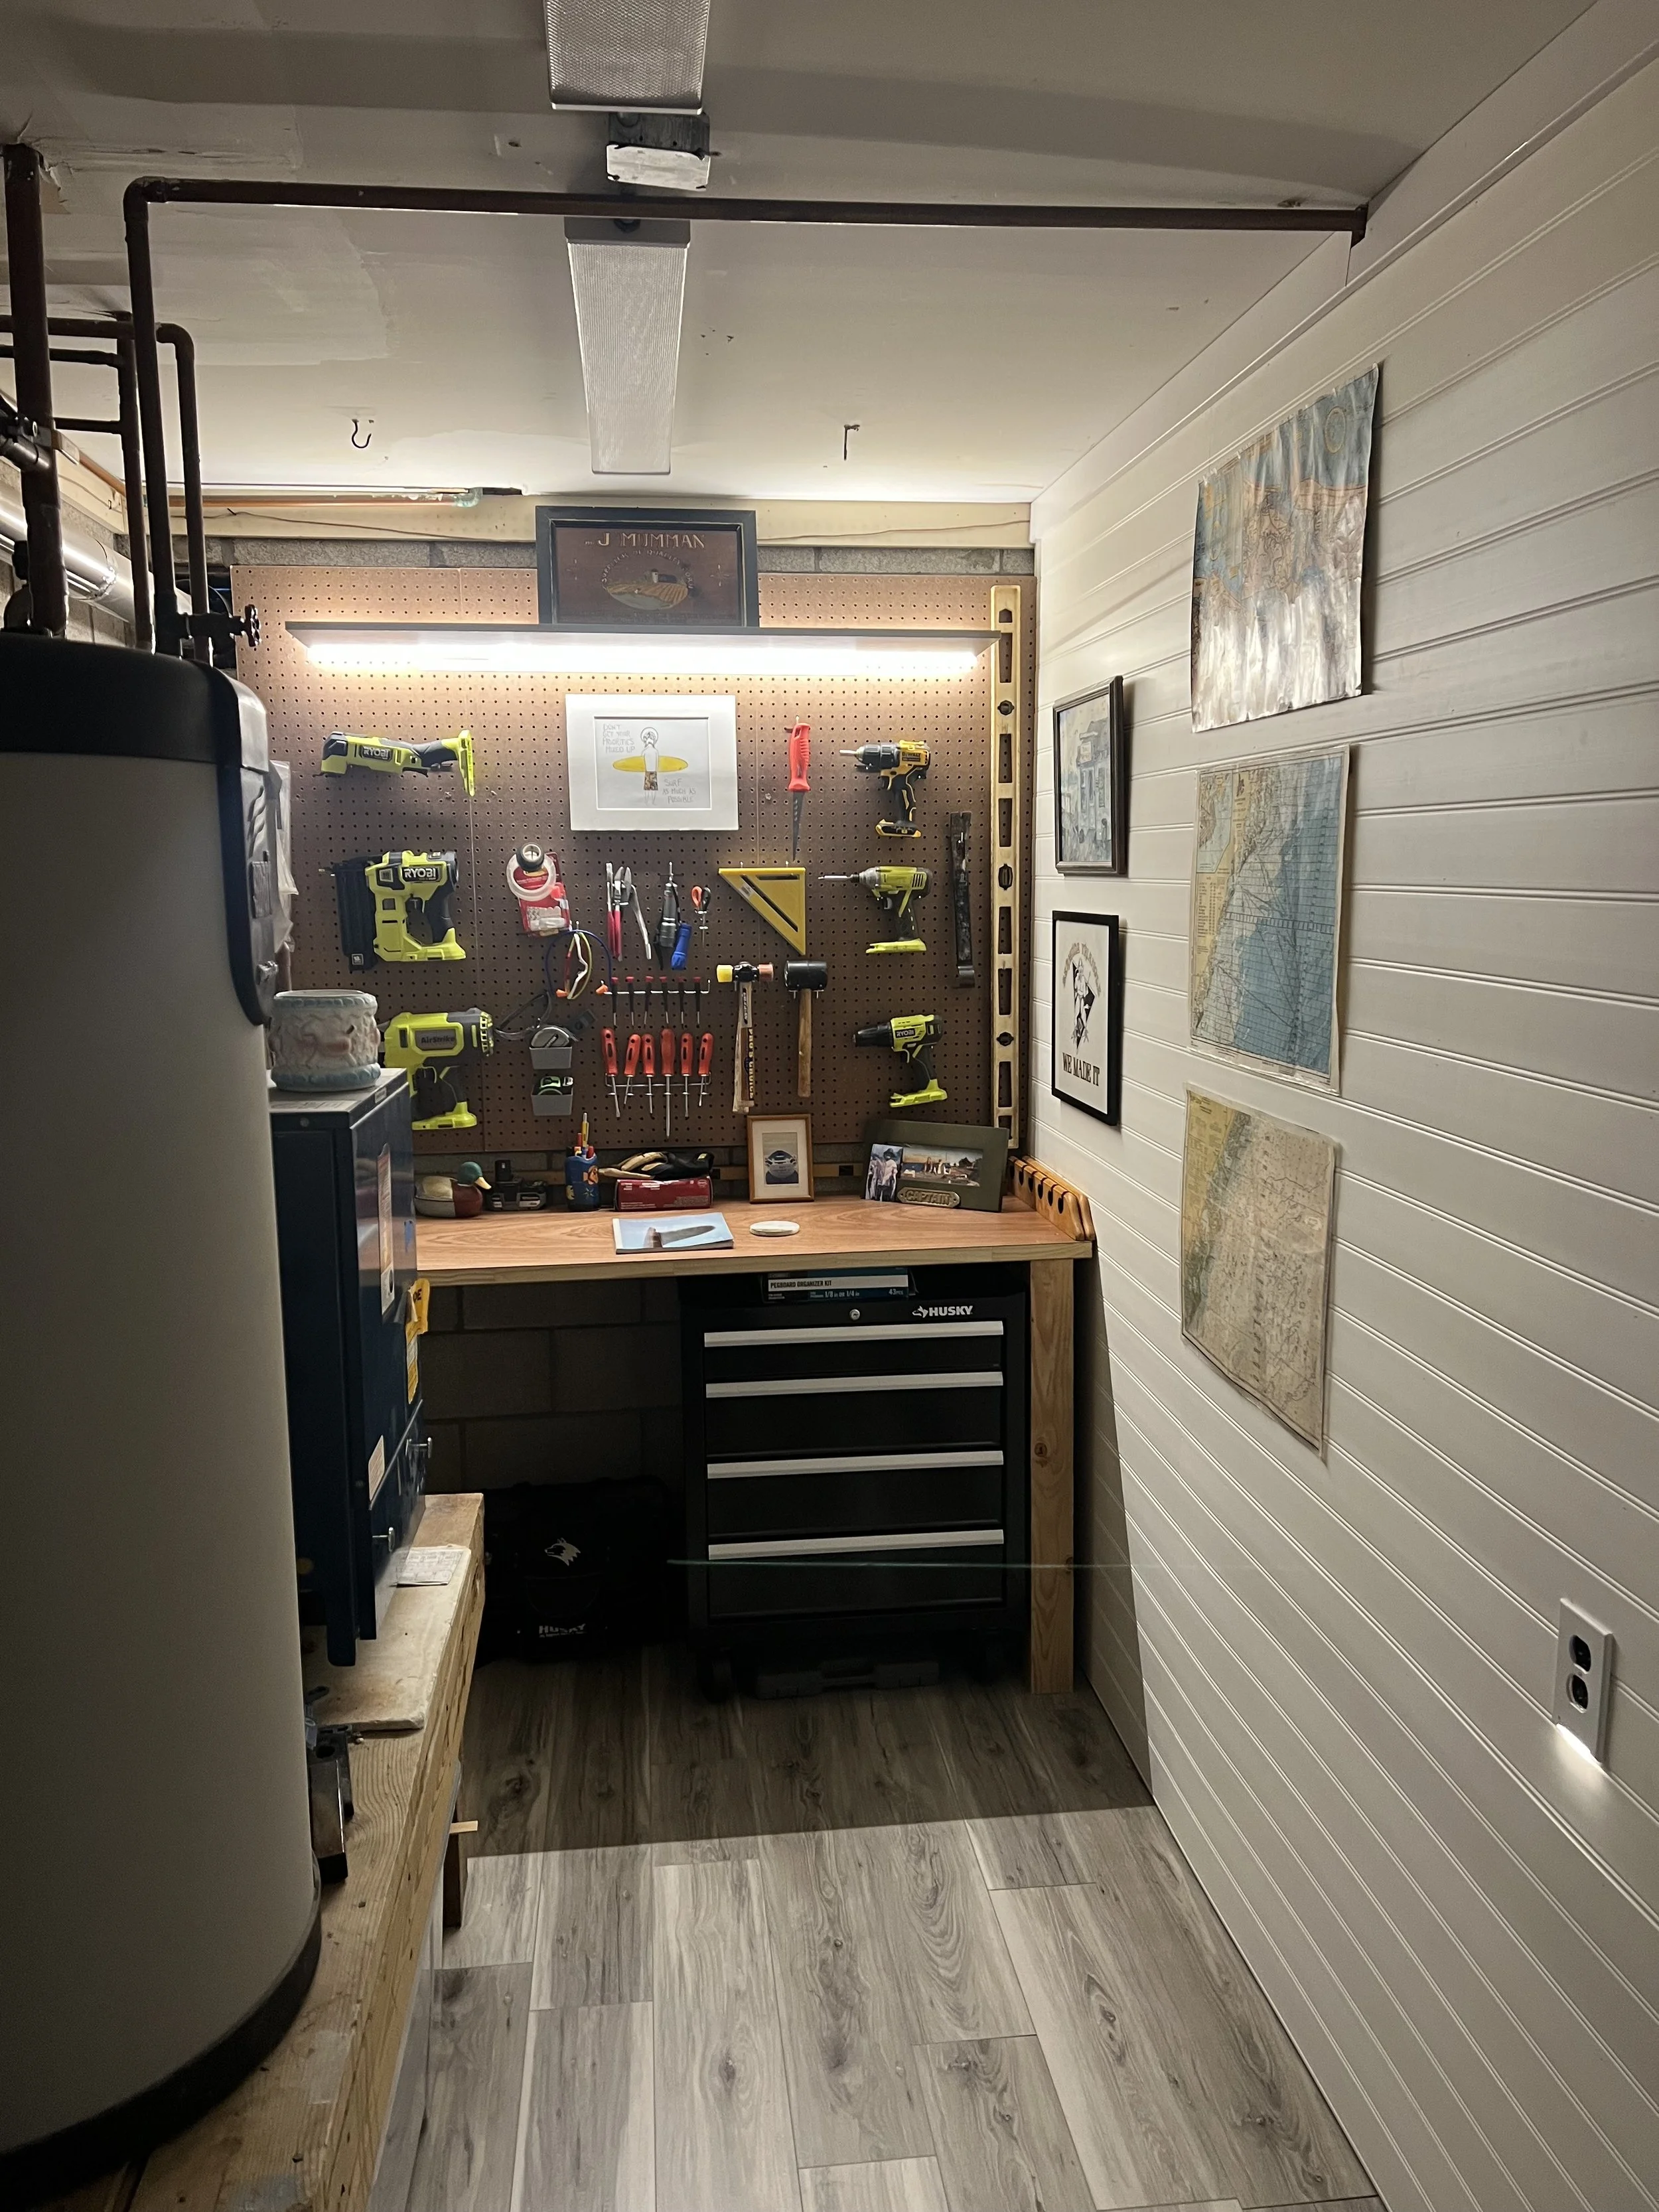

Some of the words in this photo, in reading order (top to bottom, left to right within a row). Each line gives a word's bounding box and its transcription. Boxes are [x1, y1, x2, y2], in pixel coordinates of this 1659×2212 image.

[598, 532, 610, 546] J
[363, 746, 391, 759] RYOBI
[664, 778, 684, 787] SURF
[403, 867, 436, 879] RYOBI
[1062, 1052, 1072, 1074] WE
[1072, 1055, 1092, 1083] MADE
[1092, 1065, 1100, 1086] IT
[906, 1190, 951, 1205] CAPTAIN
[929, 1305, 973, 1316] HUSKY
